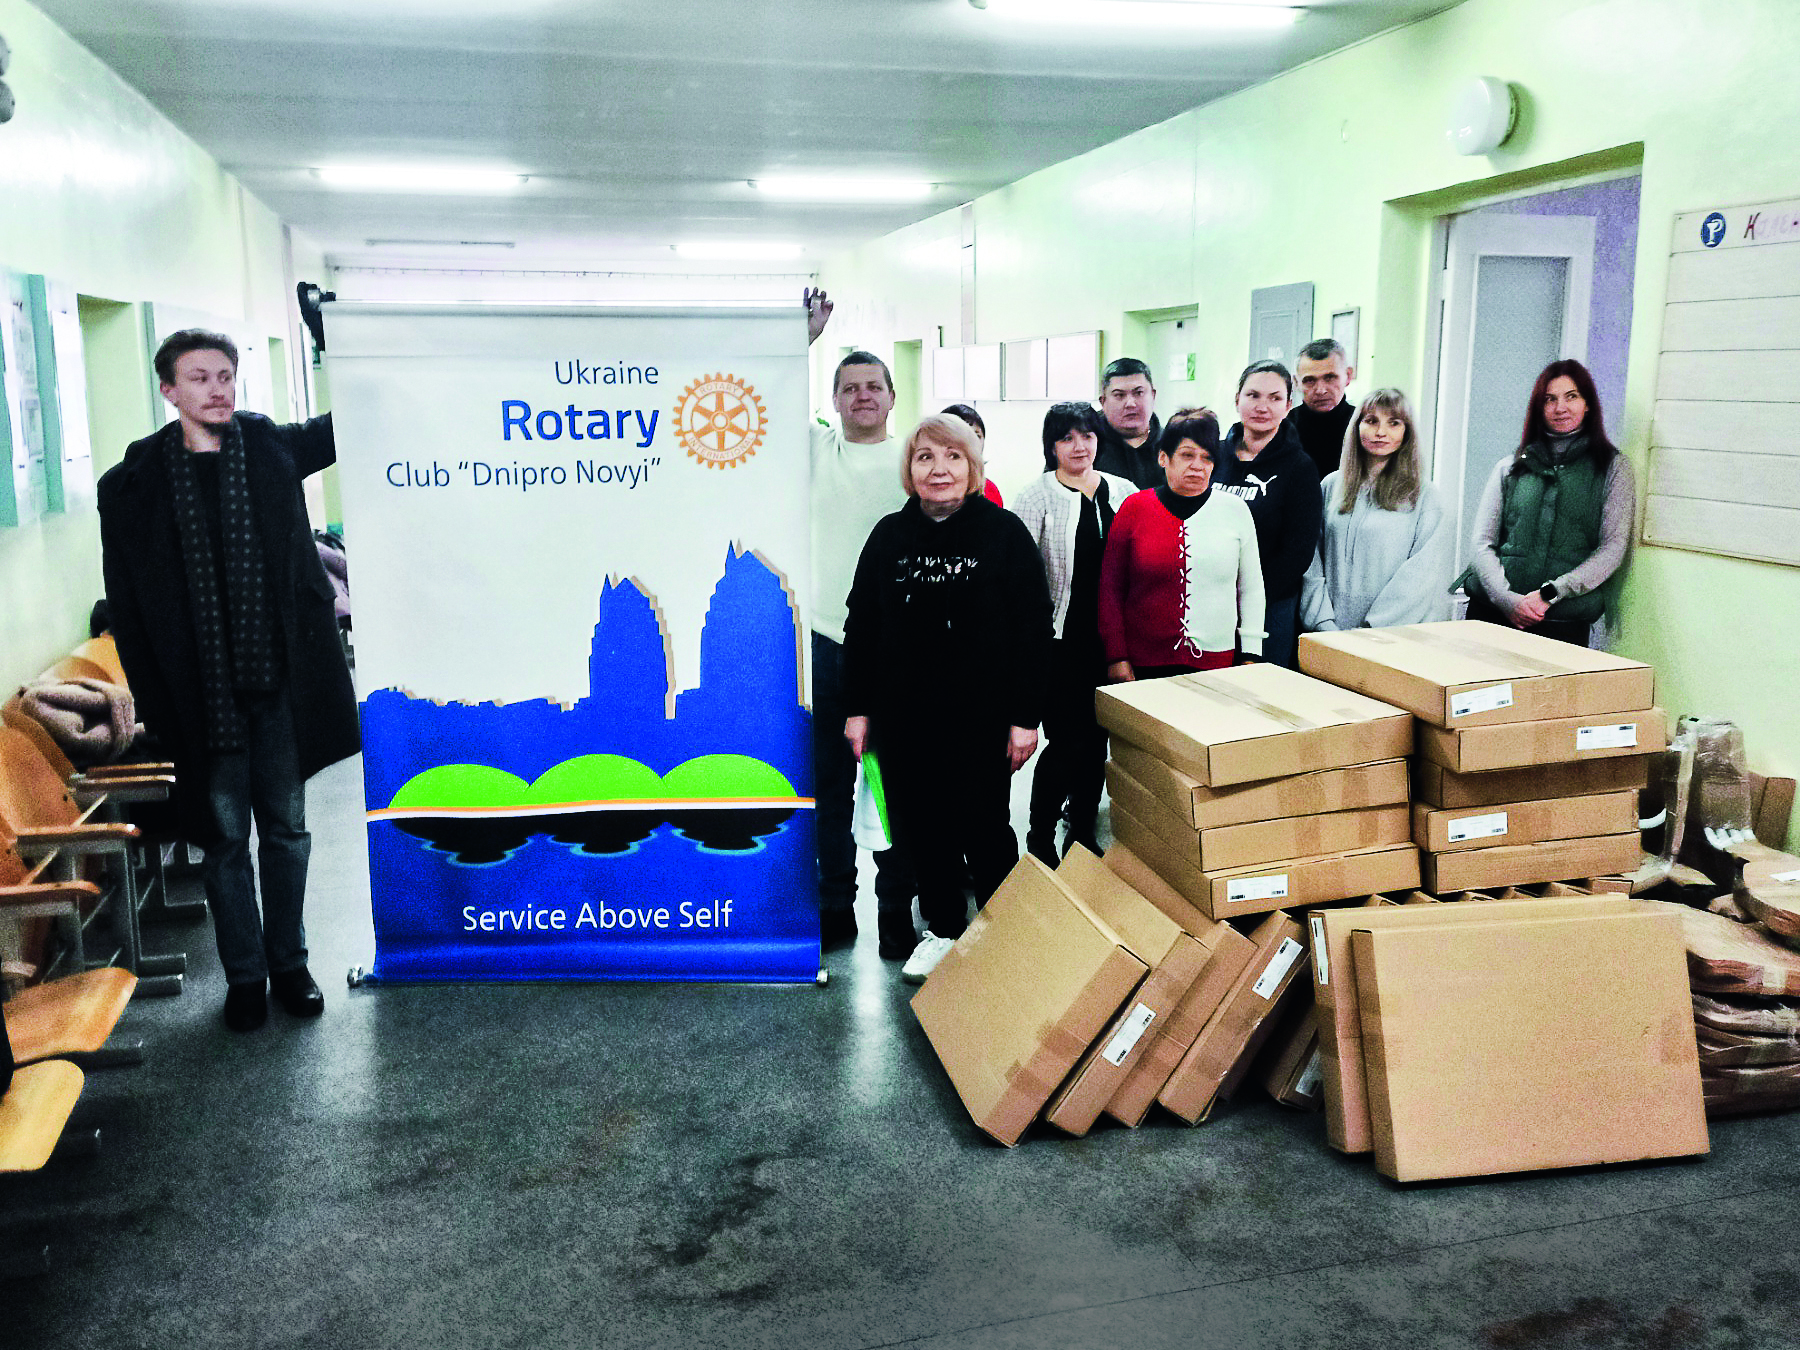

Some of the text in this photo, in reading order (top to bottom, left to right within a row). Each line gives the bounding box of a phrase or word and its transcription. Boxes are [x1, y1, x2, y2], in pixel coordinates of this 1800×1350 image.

[555, 359, 659, 385] Ukraine
[700, 382, 741, 395] ROTARY
[501, 399, 660, 448] Rotary
[688, 435, 756, 460] INTERNATIONAL
[386, 461, 450, 487] Club
[462, 899, 733, 931] Service Above Self
